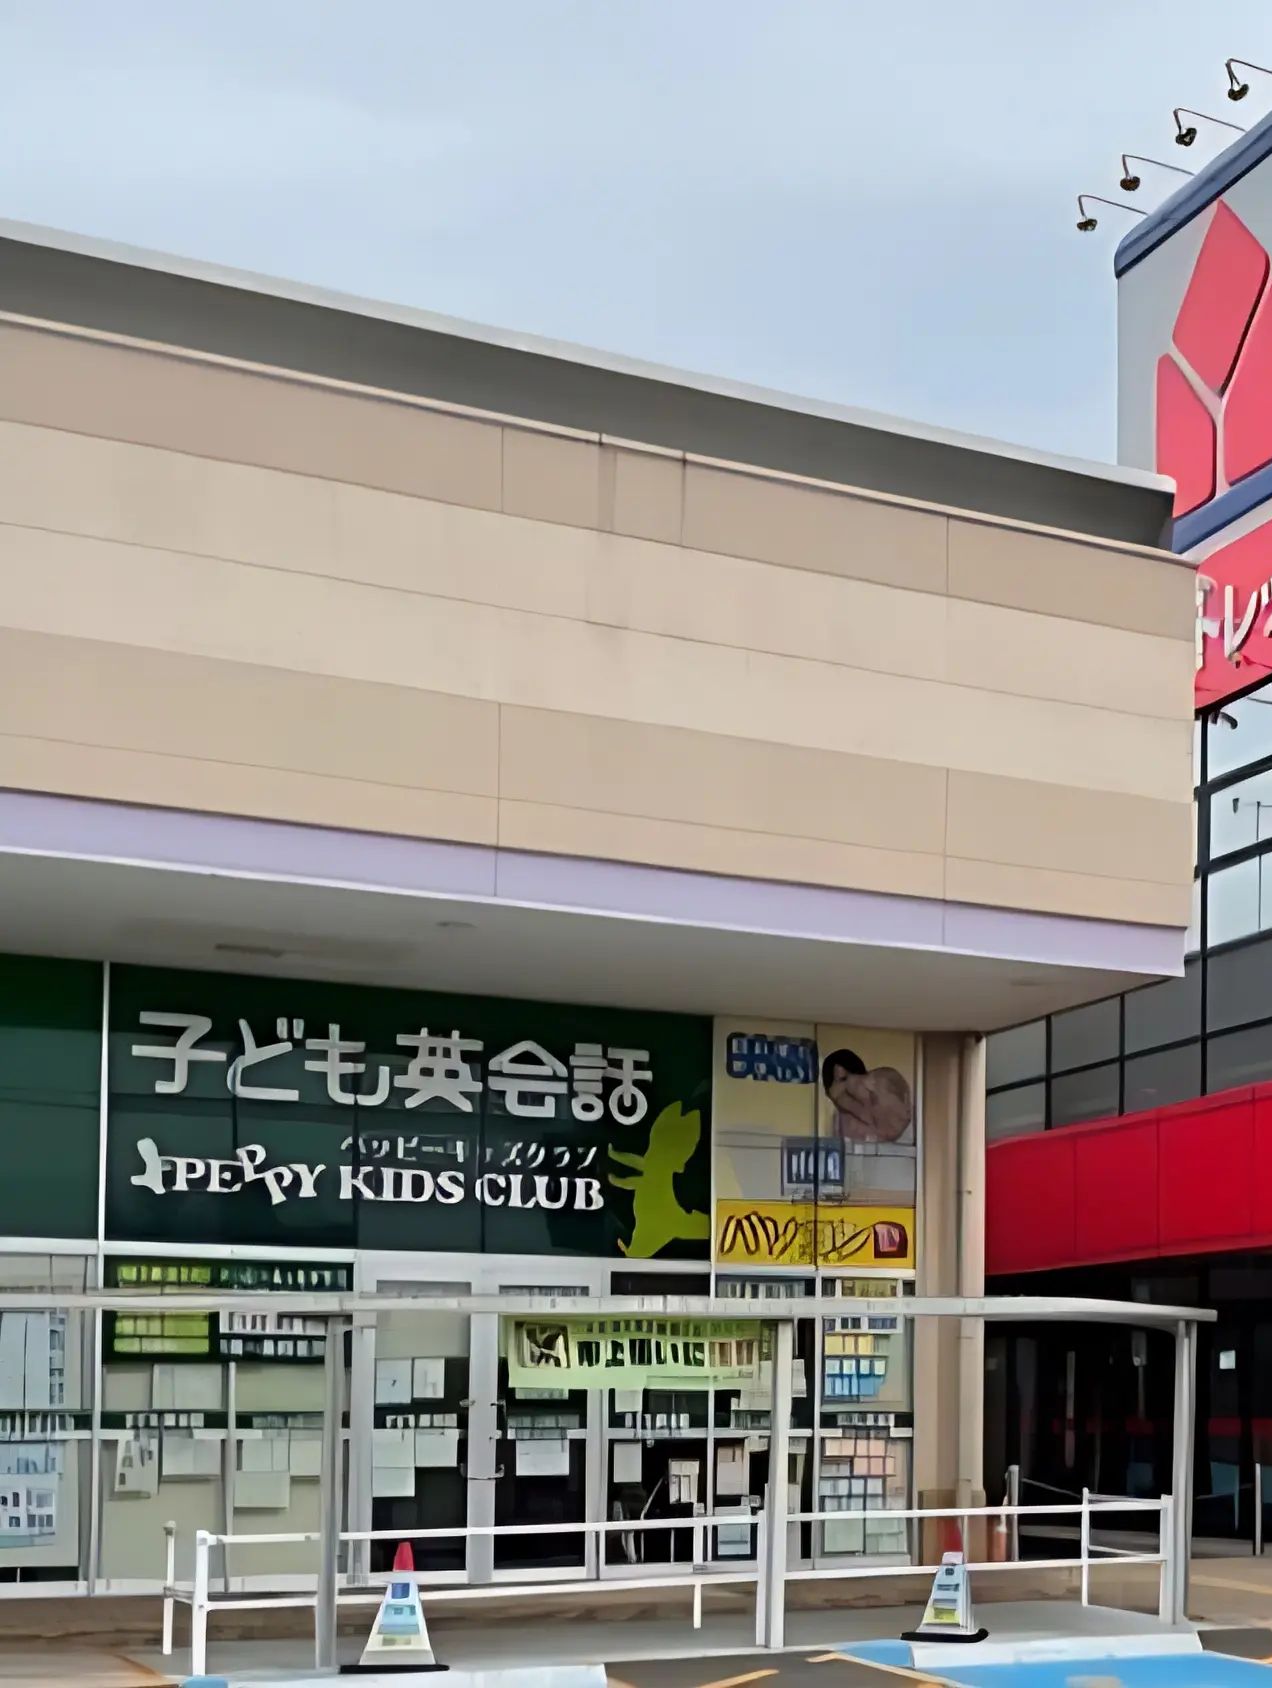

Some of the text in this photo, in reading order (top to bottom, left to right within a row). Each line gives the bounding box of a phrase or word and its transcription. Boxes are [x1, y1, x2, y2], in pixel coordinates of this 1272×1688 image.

[132, 1010, 653, 1126] 子ども英会話
[173, 1143, 605, 1211] PEPPY KIDS CLUB
